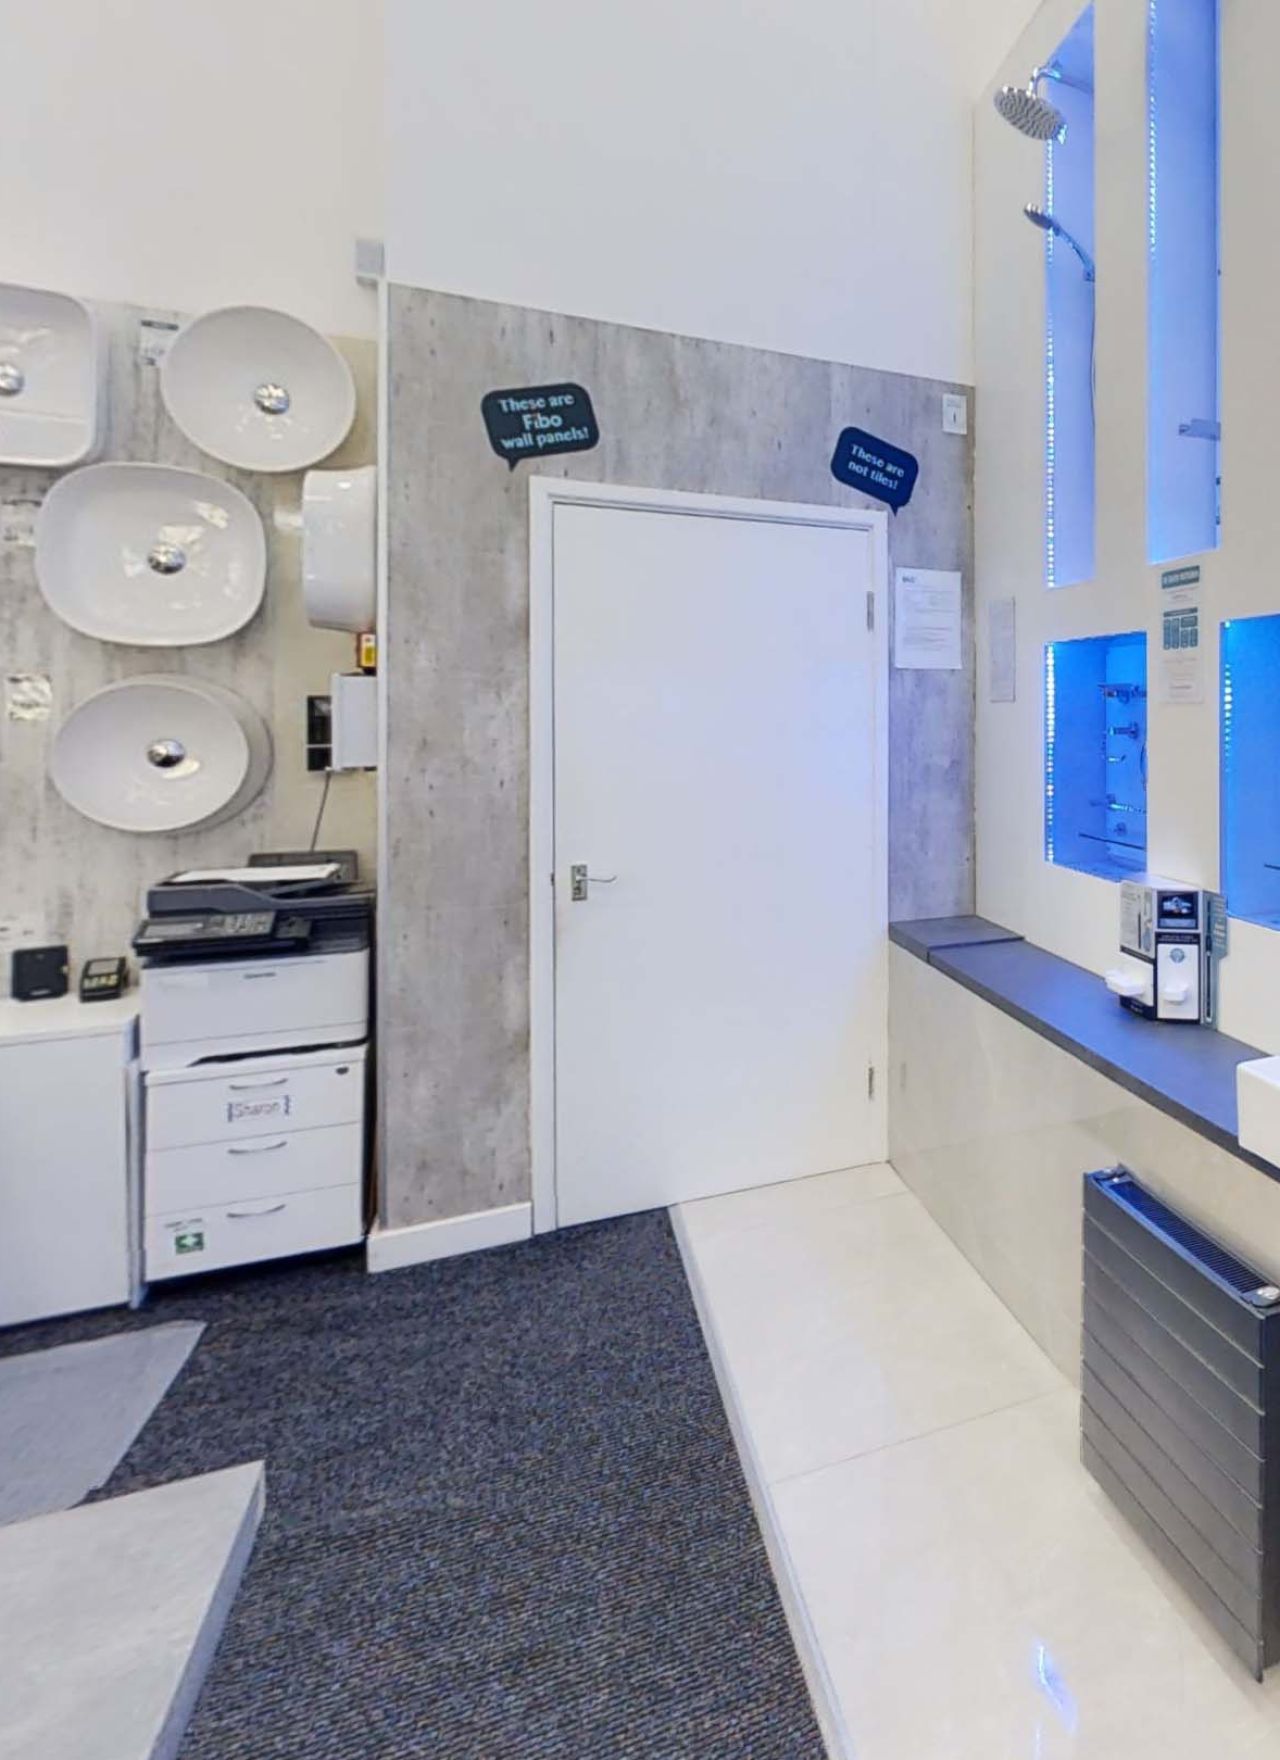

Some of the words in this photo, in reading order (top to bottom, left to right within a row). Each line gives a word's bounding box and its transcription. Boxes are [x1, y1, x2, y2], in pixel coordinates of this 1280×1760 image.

[498, 397, 546, 413] These
[548, 394, 575, 408] are
[522, 412, 563, 430] Fibo
[501, 432, 535, 450] wall
[536, 426, 590, 449] panels!
[851, 444, 885, 468] These
[886, 462, 905, 478] are
[848, 461, 869, 477] not
[870, 470, 899, 490] tiles!
